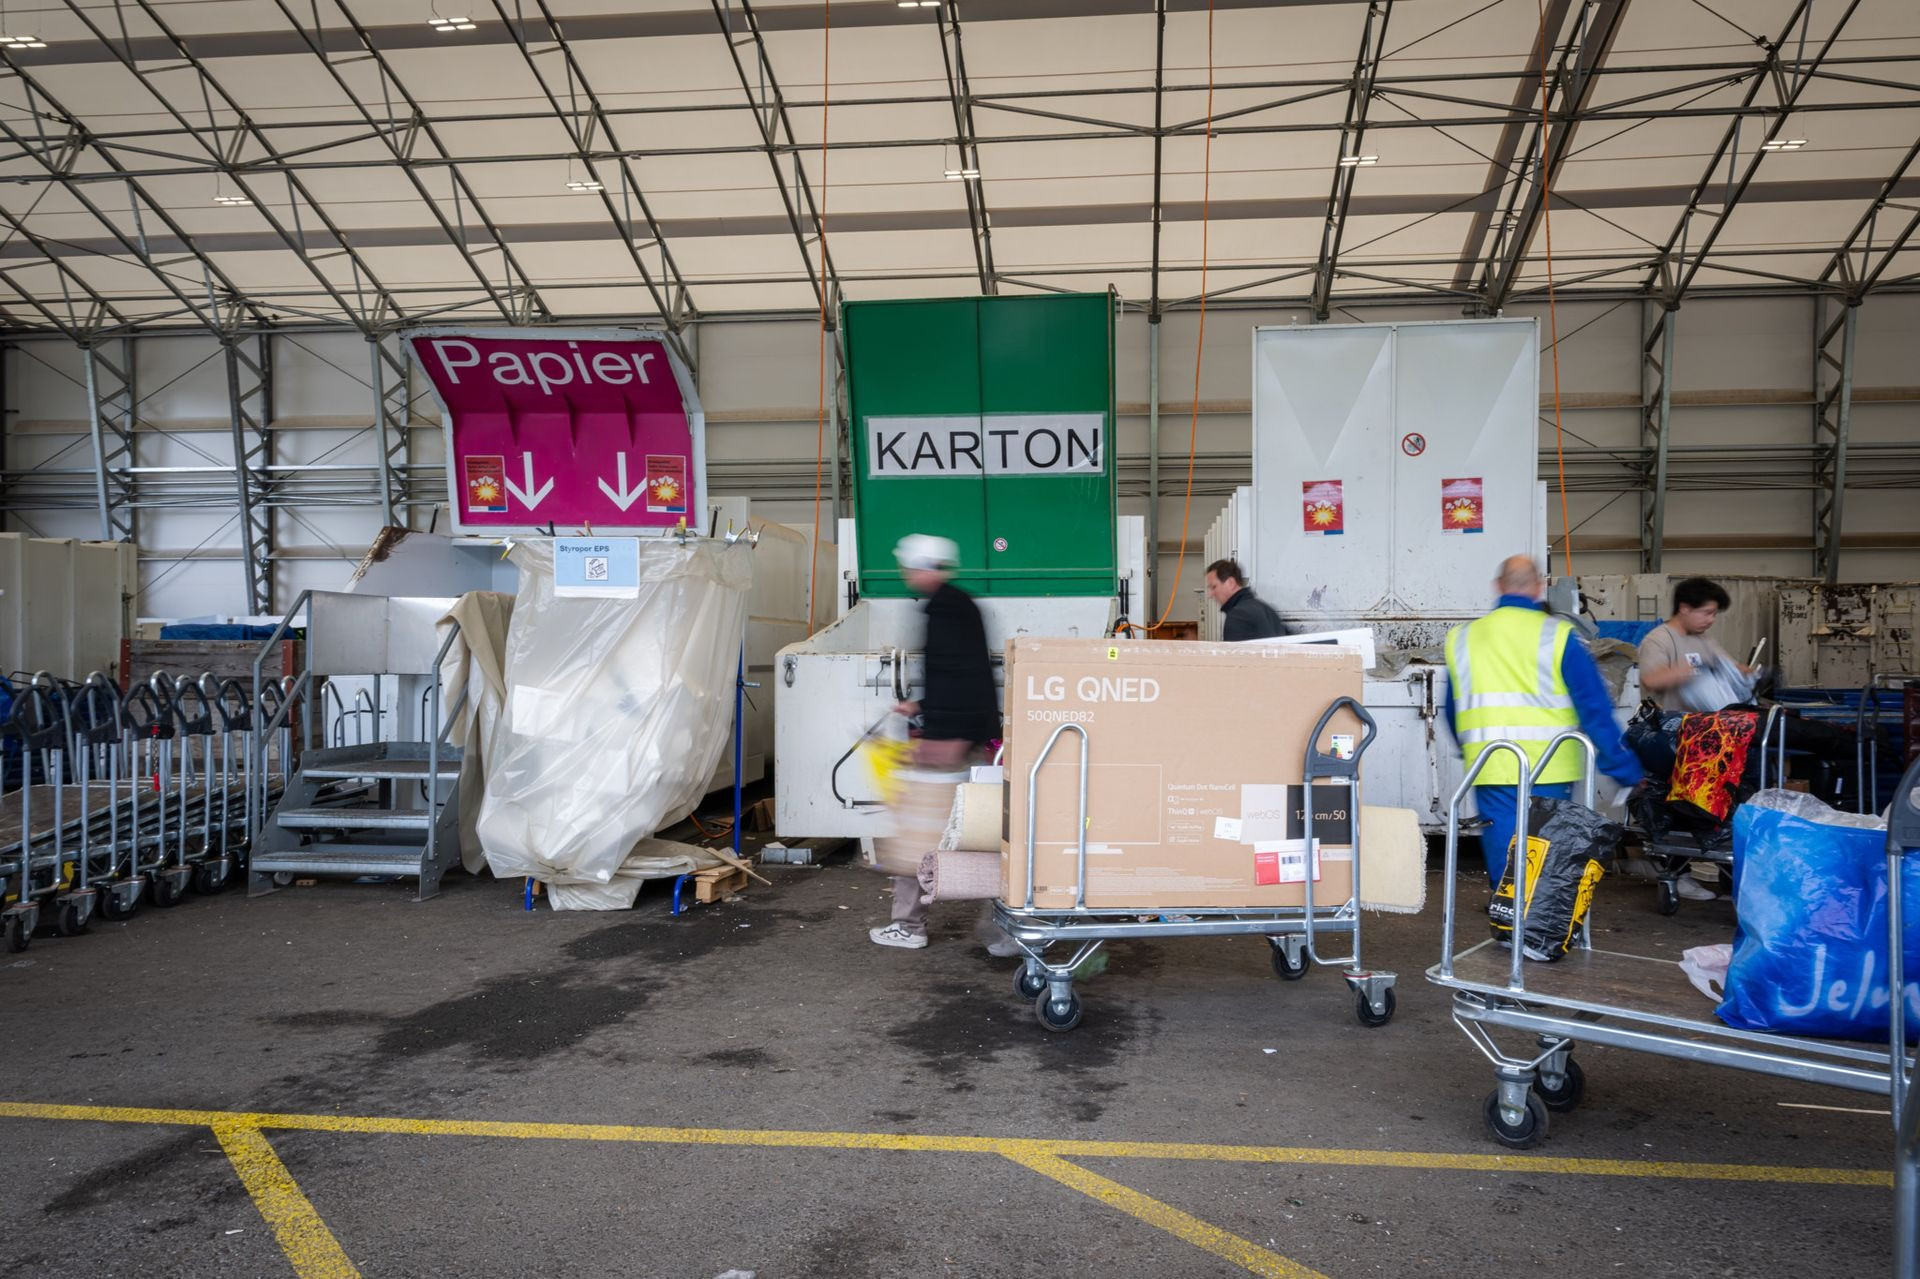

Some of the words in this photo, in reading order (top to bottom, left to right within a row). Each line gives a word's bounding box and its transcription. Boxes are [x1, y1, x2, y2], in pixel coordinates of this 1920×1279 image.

[431, 340, 655, 395] Papier
[876, 428, 1099, 470] KARTON
[560, 545, 592, 553] Styropor
[1027, 675, 1065, 701] LG
[1077, 676, 1161, 703] QNED
[1027, 710, 1095, 722] 50QNED82
[1247, 809, 1280, 820] webOS
